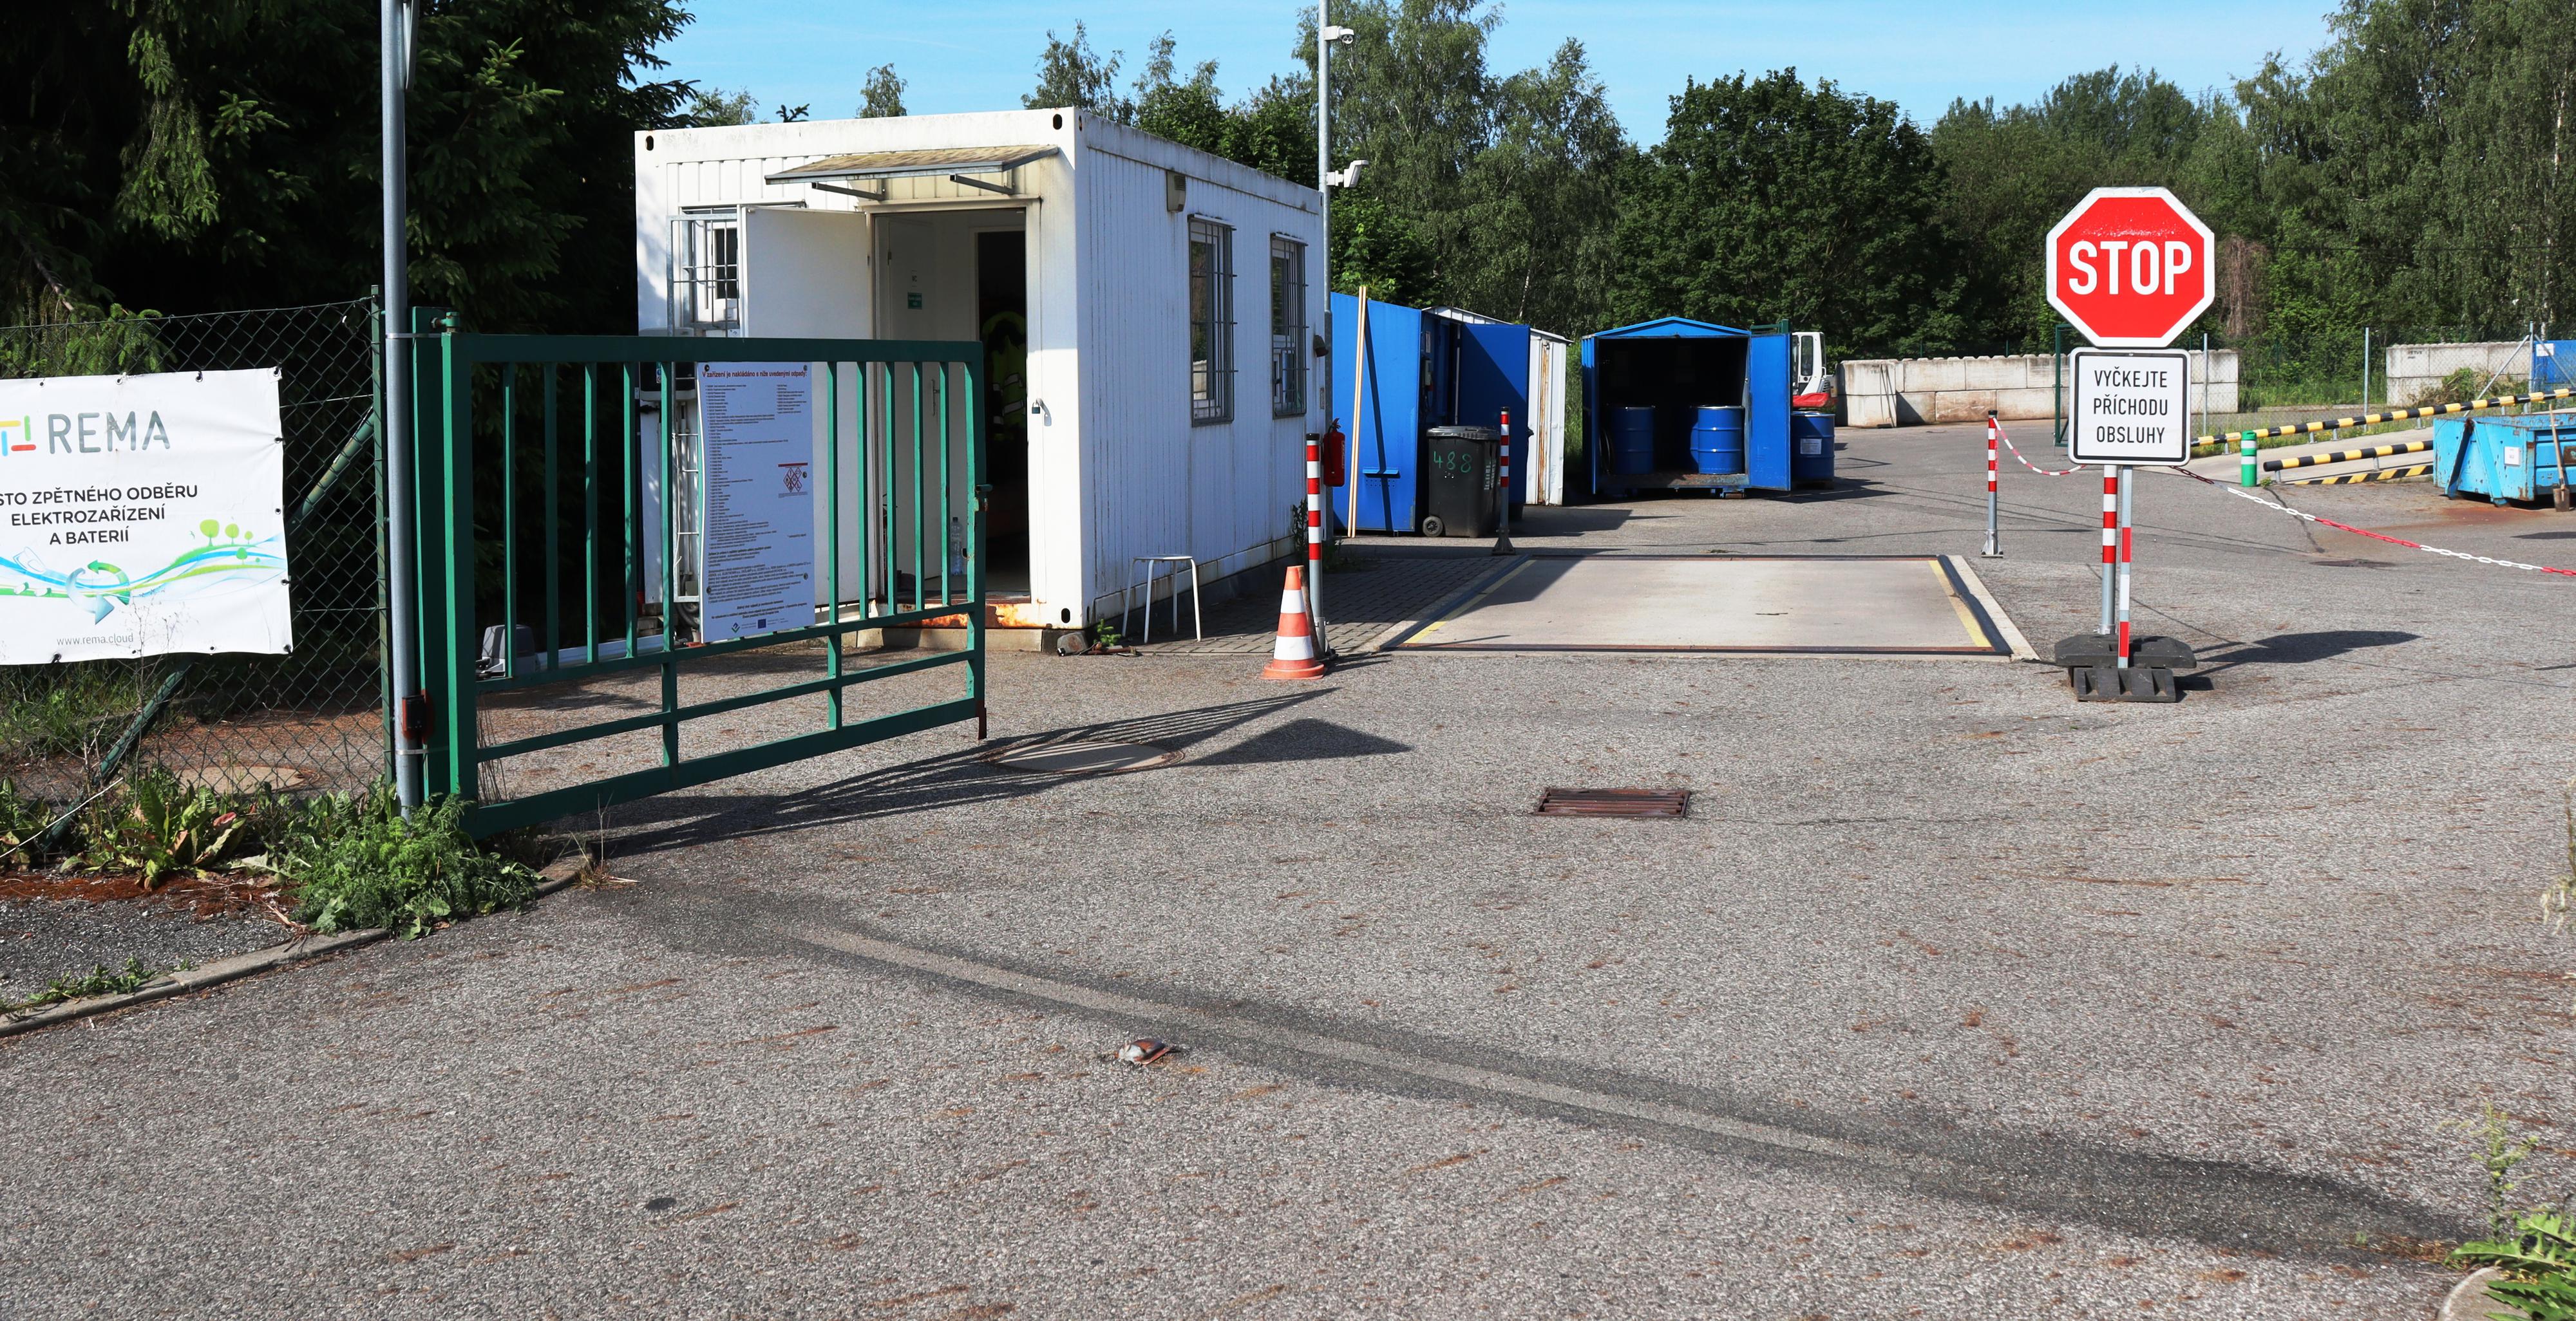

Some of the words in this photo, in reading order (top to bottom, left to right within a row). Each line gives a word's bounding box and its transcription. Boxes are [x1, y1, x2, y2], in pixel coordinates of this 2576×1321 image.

[2069, 241, 2192, 295] STOP
[2094, 366, 2168, 388] VYČKEJTE
[2093, 394, 2168, 416] PŘÍCHODU
[48, 410, 171, 454] REMA
[2096, 426, 2165, 444] OBSLUHY
[1433, 451, 1472, 473] 488
[32, 486, 122, 504] ZPĚTNÉHO
[126, 482, 198, 500] ODBĚRU
[11, 503, 166, 526] ELEKTROZAŘÍZENÍ
[50, 532, 61, 545] A
[66, 526, 129, 545] BATERIÍ
[57, 632, 134, 646] www.rema.cloud
